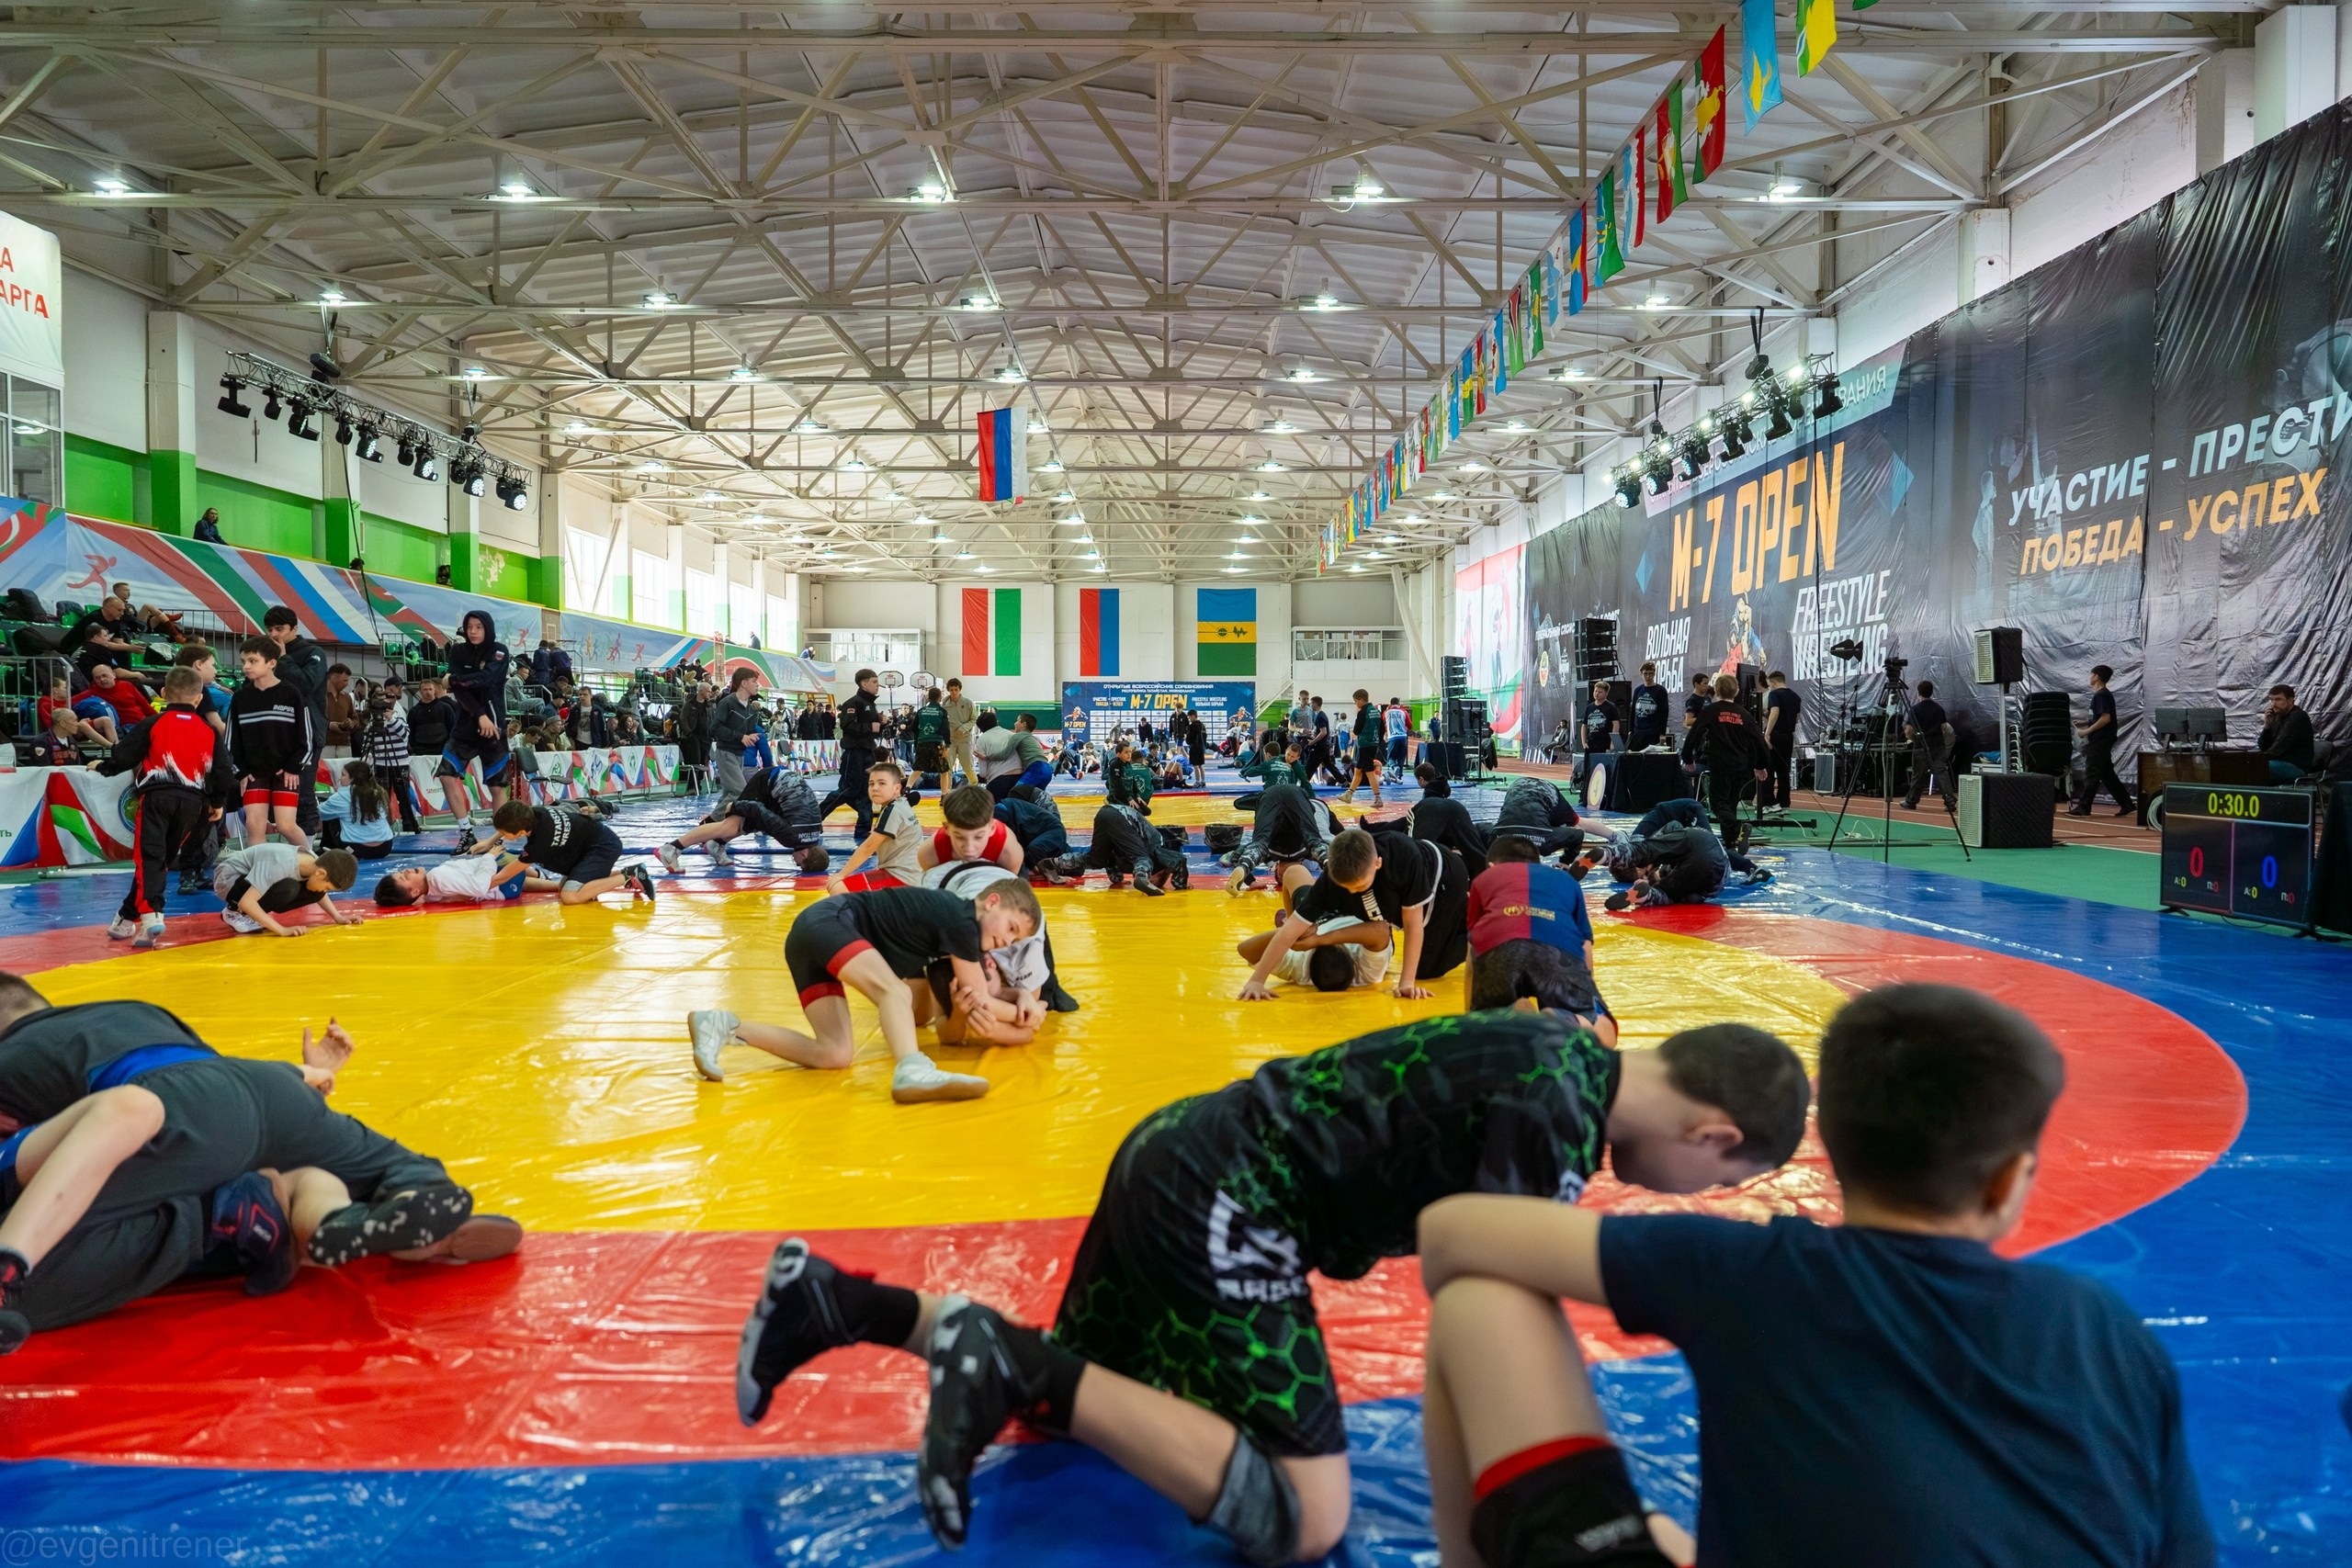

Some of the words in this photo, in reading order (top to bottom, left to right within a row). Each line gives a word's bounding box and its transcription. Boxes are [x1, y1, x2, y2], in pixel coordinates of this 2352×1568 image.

[2008, 454, 2150, 526] УЧАСТИЕ
[1732, 441, 1845, 596] OPEN
[2020, 515, 2143, 575] ПОБЕДА
[2184, 468, 2328, 541] УСПЕХ
[1792, 570, 1891, 634] FREESTYLE
[1645, 616, 1690, 660] ВОЛЬНАЯ
[1653, 656, 1684, 694] ОРЬБА
[1154, 694, 1188, 709] OPEN
[2208, 793, 2260, 817] 0:30.0
[2190, 847, 2204, 877] 0
[2262, 855, 2278, 888] 0
